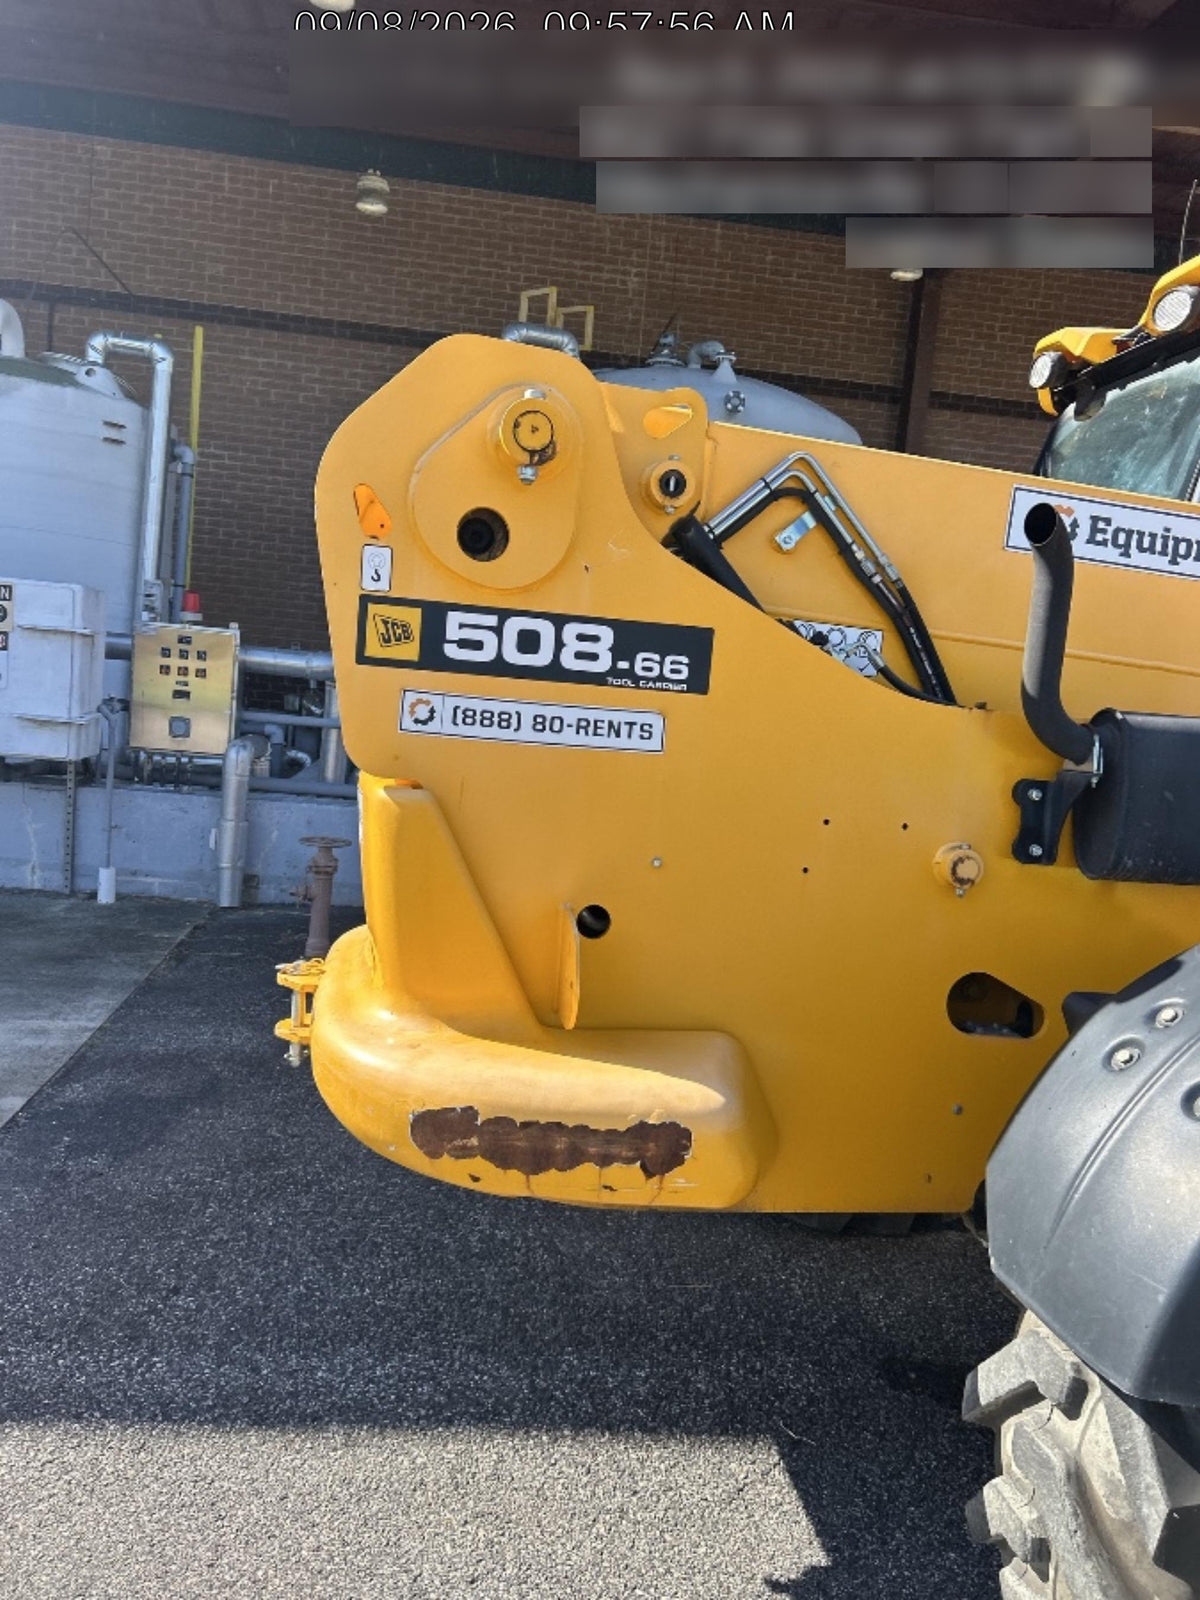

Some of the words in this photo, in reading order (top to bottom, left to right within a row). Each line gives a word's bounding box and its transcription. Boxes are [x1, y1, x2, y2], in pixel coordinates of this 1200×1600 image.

[377, 616, 413, 645] JCB
[443, 610, 689, 680] 508-66
[606, 677, 636, 687] TOOL
[451, 705, 522, 732] (888)
[531, 713, 654, 741] 80-RENTS
